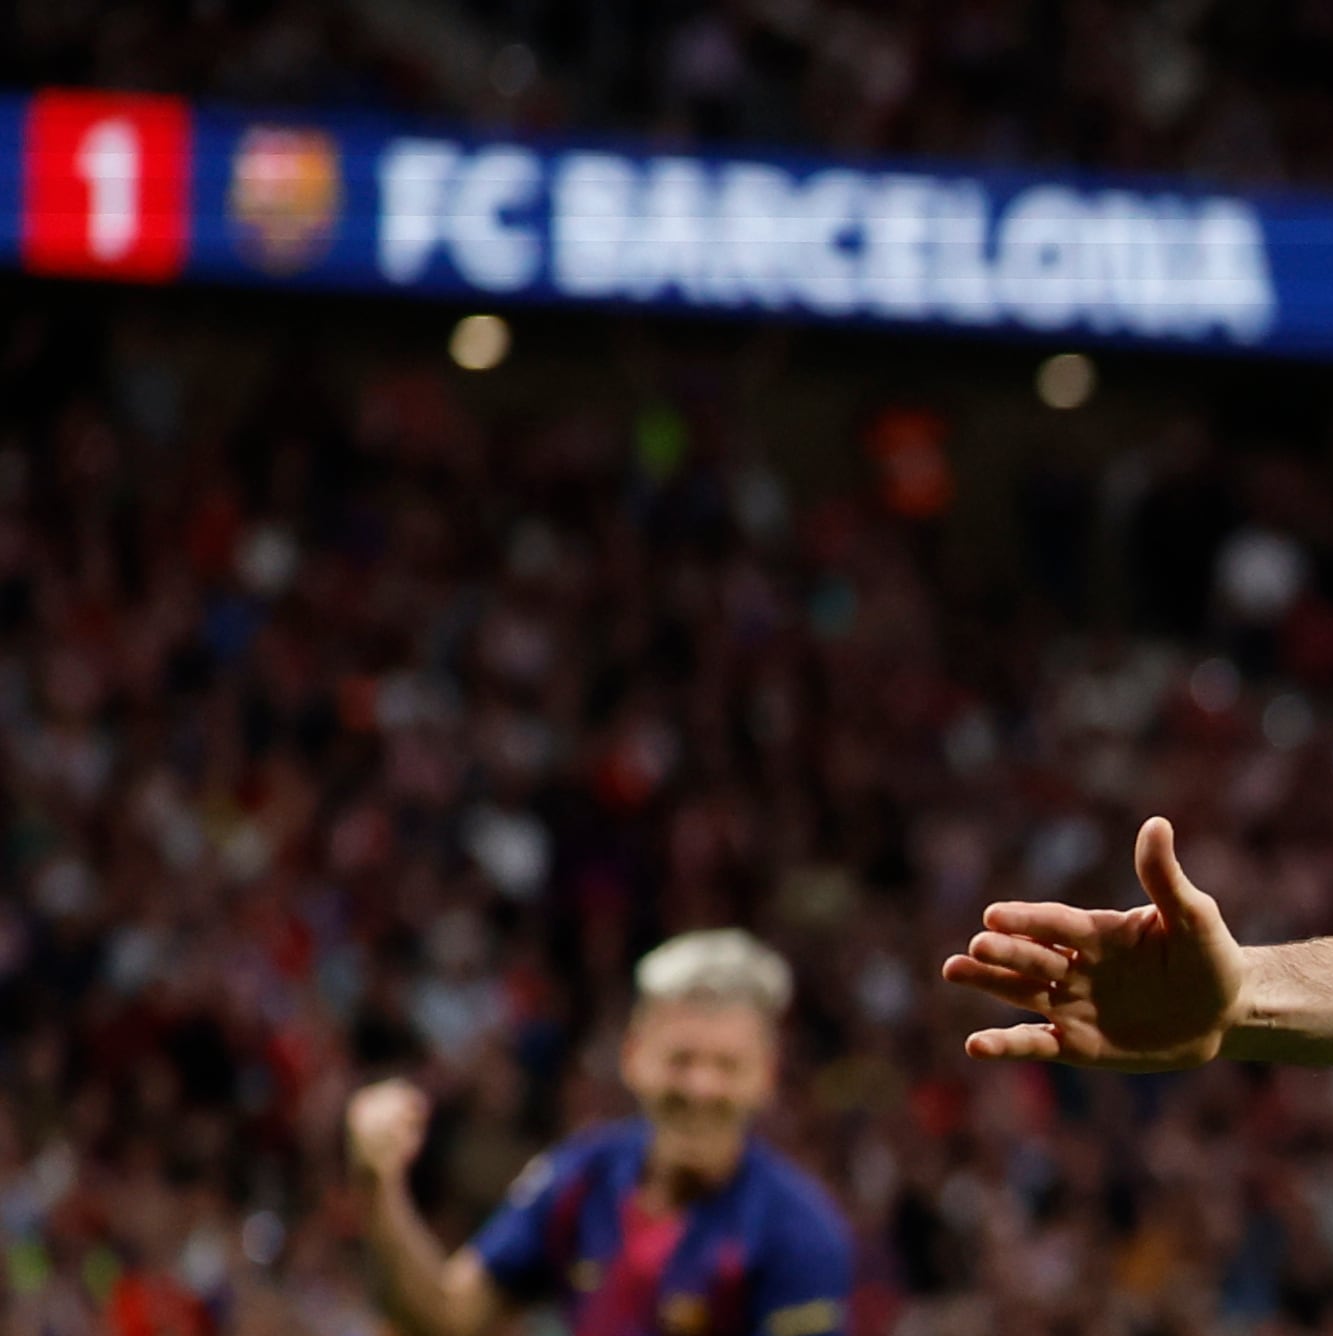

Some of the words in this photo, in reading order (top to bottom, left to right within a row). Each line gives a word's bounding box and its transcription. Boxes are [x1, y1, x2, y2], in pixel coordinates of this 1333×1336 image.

[74, 122, 140, 260] 1
[378, 140, 545, 292] FC
[553, 152, 1278, 342] BARCELONA
